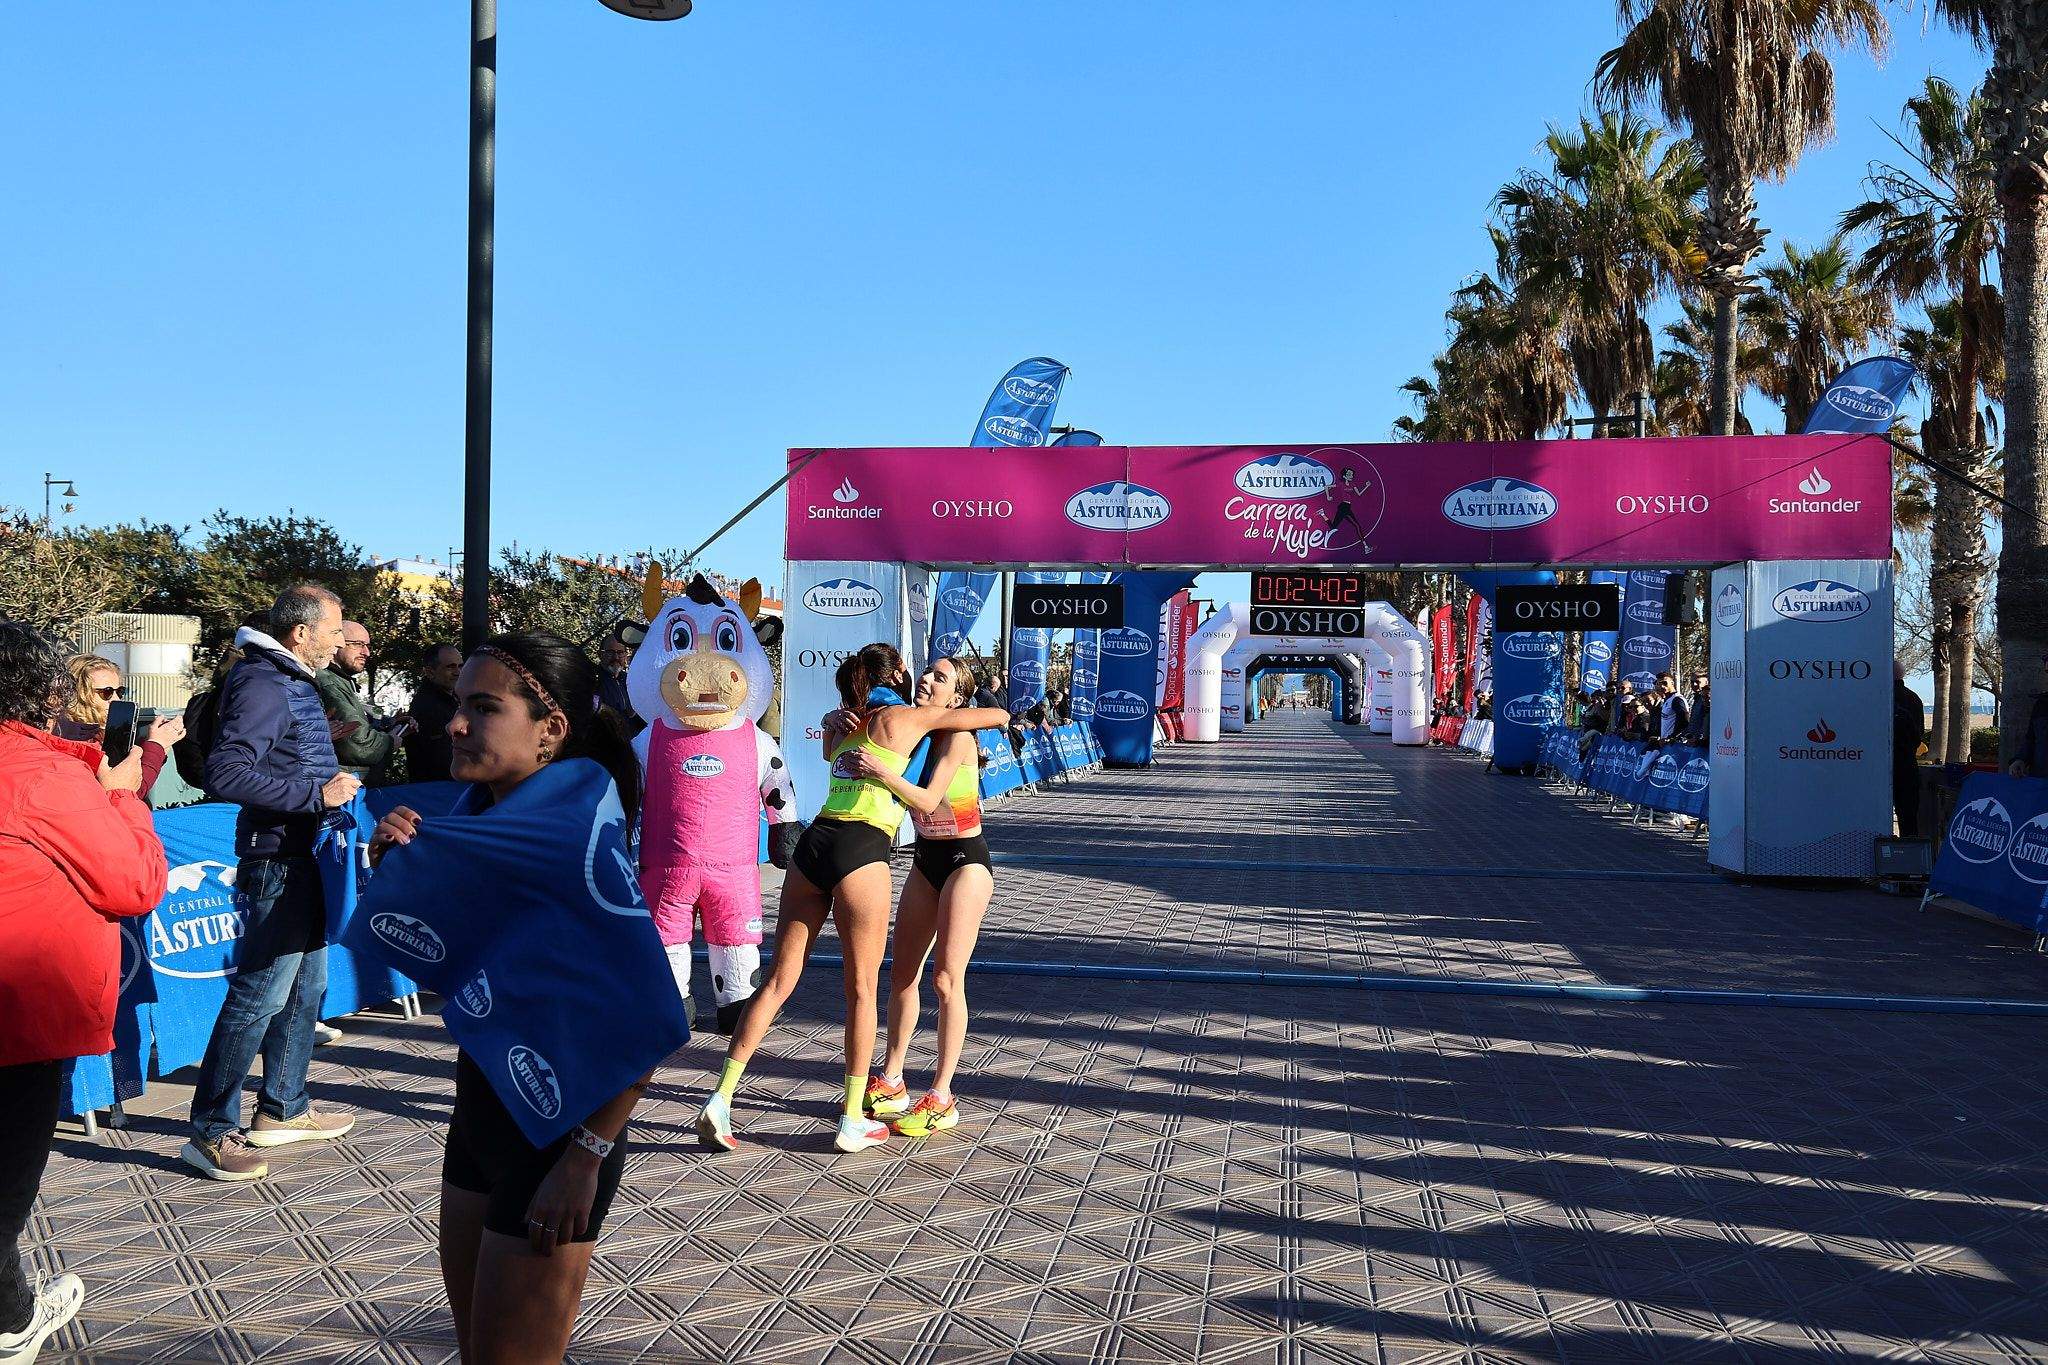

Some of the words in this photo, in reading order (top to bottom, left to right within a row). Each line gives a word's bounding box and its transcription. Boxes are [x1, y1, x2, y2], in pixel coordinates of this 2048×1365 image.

[1830, 390, 1889, 418] ASTURIANA
[1242, 470, 1327, 488] ASTURIANA
[808, 505, 883, 519] Santander
[931, 499, 1013, 519] OYSHO
[1072, 499, 1163, 518] ASTURIANA
[1224, 496, 1308, 520] Carrera
[1451, 497, 1549, 516] ASTURIANA
[1616, 494, 1709, 514] OYSHO
[1769, 498, 1862, 513] Santander
[1244, 521, 1260, 539] de
[1263, 521, 1275, 539] la
[1271, 520, 1339, 558] Mujer
[1258, 576, 1359, 603] 00:24:02
[809, 593, 877, 607] ASTURIANA
[1031, 598, 1108, 615] OYSHO
[1515, 600, 1601, 618] OYSHO
[1780, 596, 1863, 611] ASTURIANA
[1255, 611, 1360, 633] OYSHO
[1630, 607, 1663, 619] ASTURIA
[1169, 605, 1181, 655] Santander
[1101, 636, 1149, 651] ASTURIANA
[1441, 619, 1449, 663] Santander
[798, 649, 852, 668] OYS
[1714, 659, 1742, 680] OYSHO
[1769, 659, 1872, 680] OYSHO
[1166, 670, 1177, 701] Sports
[1096, 700, 1145, 714] ASTURIANA
[1779, 746, 1864, 760] Santander
[1952, 814, 2005, 852] ASTURIANA
[2011, 832, 2048, 866] ASTUR
[169, 895, 224, 915] CENTRAL
[151, 909, 246, 959] ASTUR
[374, 917, 439, 960] ASTURIANA
[462, 982, 484, 1014] RIANA
[511, 1052, 553, 1115] ASTURIANA
